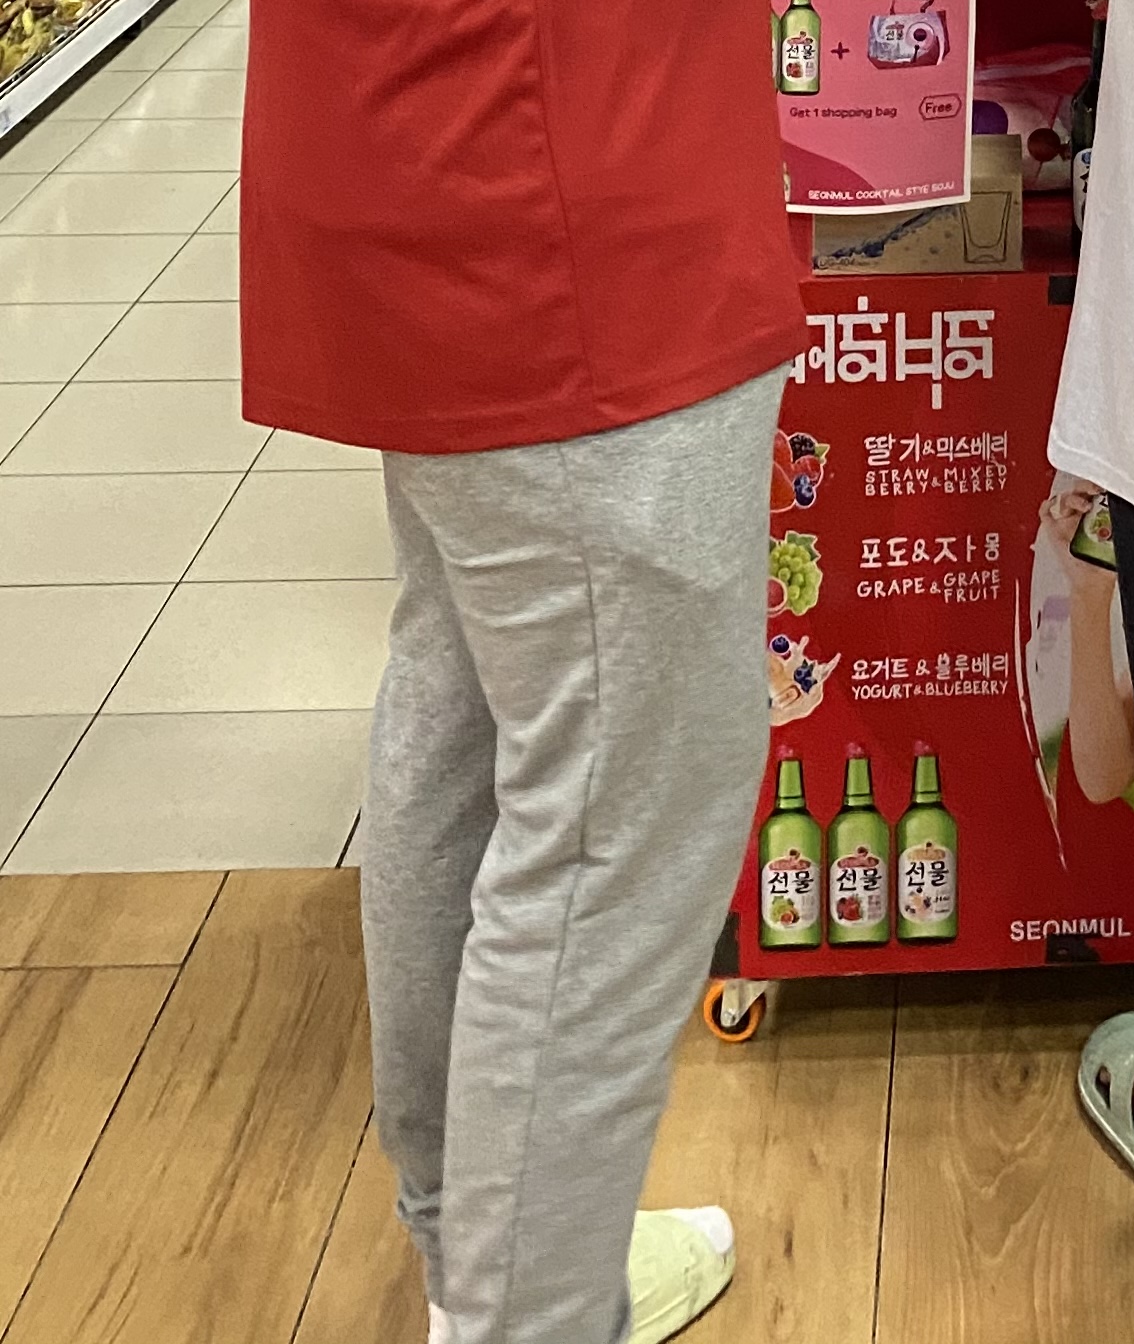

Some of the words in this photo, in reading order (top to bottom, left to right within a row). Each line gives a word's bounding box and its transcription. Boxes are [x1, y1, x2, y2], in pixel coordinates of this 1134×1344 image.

[789, 106, 811, 118] Get
[821, 106, 873, 120] shopping
[875, 105, 898, 119] bag
[925, 102, 953, 114] Free
[808, 189, 853, 201] SEONMUL
[855, 188, 903, 200] COCKTAIL
[866, 468, 930, 484] STRAW
[943, 466, 1008, 481] MIXED
[865, 481, 929, 496] BERRY
[944, 478, 1007, 494] BERRY
[857, 577, 925, 598] GRAPE
[943, 569, 1001, 586] GRAPE
[943, 585, 1001, 603] FRUIT
[852, 657, 909, 681] 요거트
[768, 870, 814, 894] 선물
[836, 868, 882, 892] 선물
[905, 861, 950, 888] 선물
[1010, 917, 1132, 942] SEONMUL
